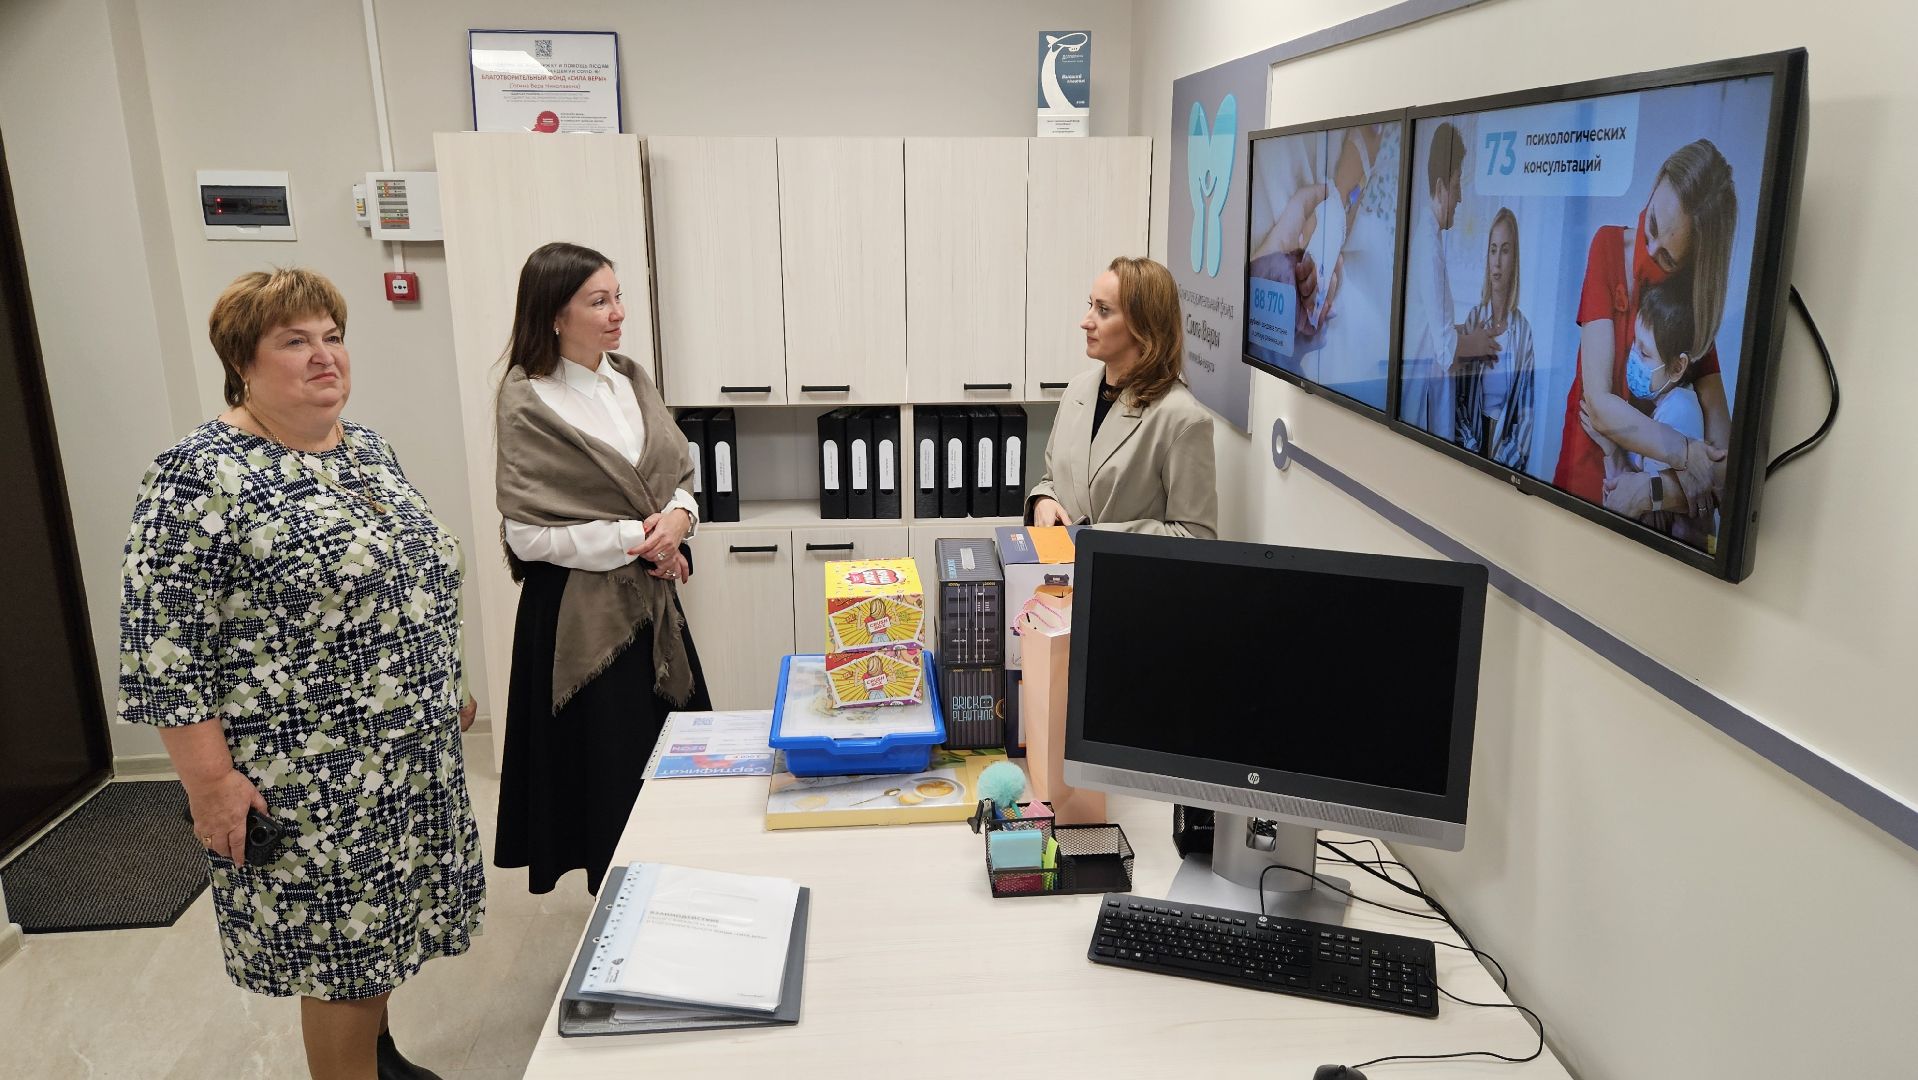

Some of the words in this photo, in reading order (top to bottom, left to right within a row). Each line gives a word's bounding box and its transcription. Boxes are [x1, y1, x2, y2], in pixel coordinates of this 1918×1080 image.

[1526, 126, 1628, 146] психологических
[1485, 131, 1517, 176] 73
[1524, 154, 1602, 176] консультаций
[1254, 288, 1265, 310] 88
[1268, 290, 1285, 315] 770
[952, 695, 980, 710] BRICK
[659, 766, 767, 775] Сертификат
